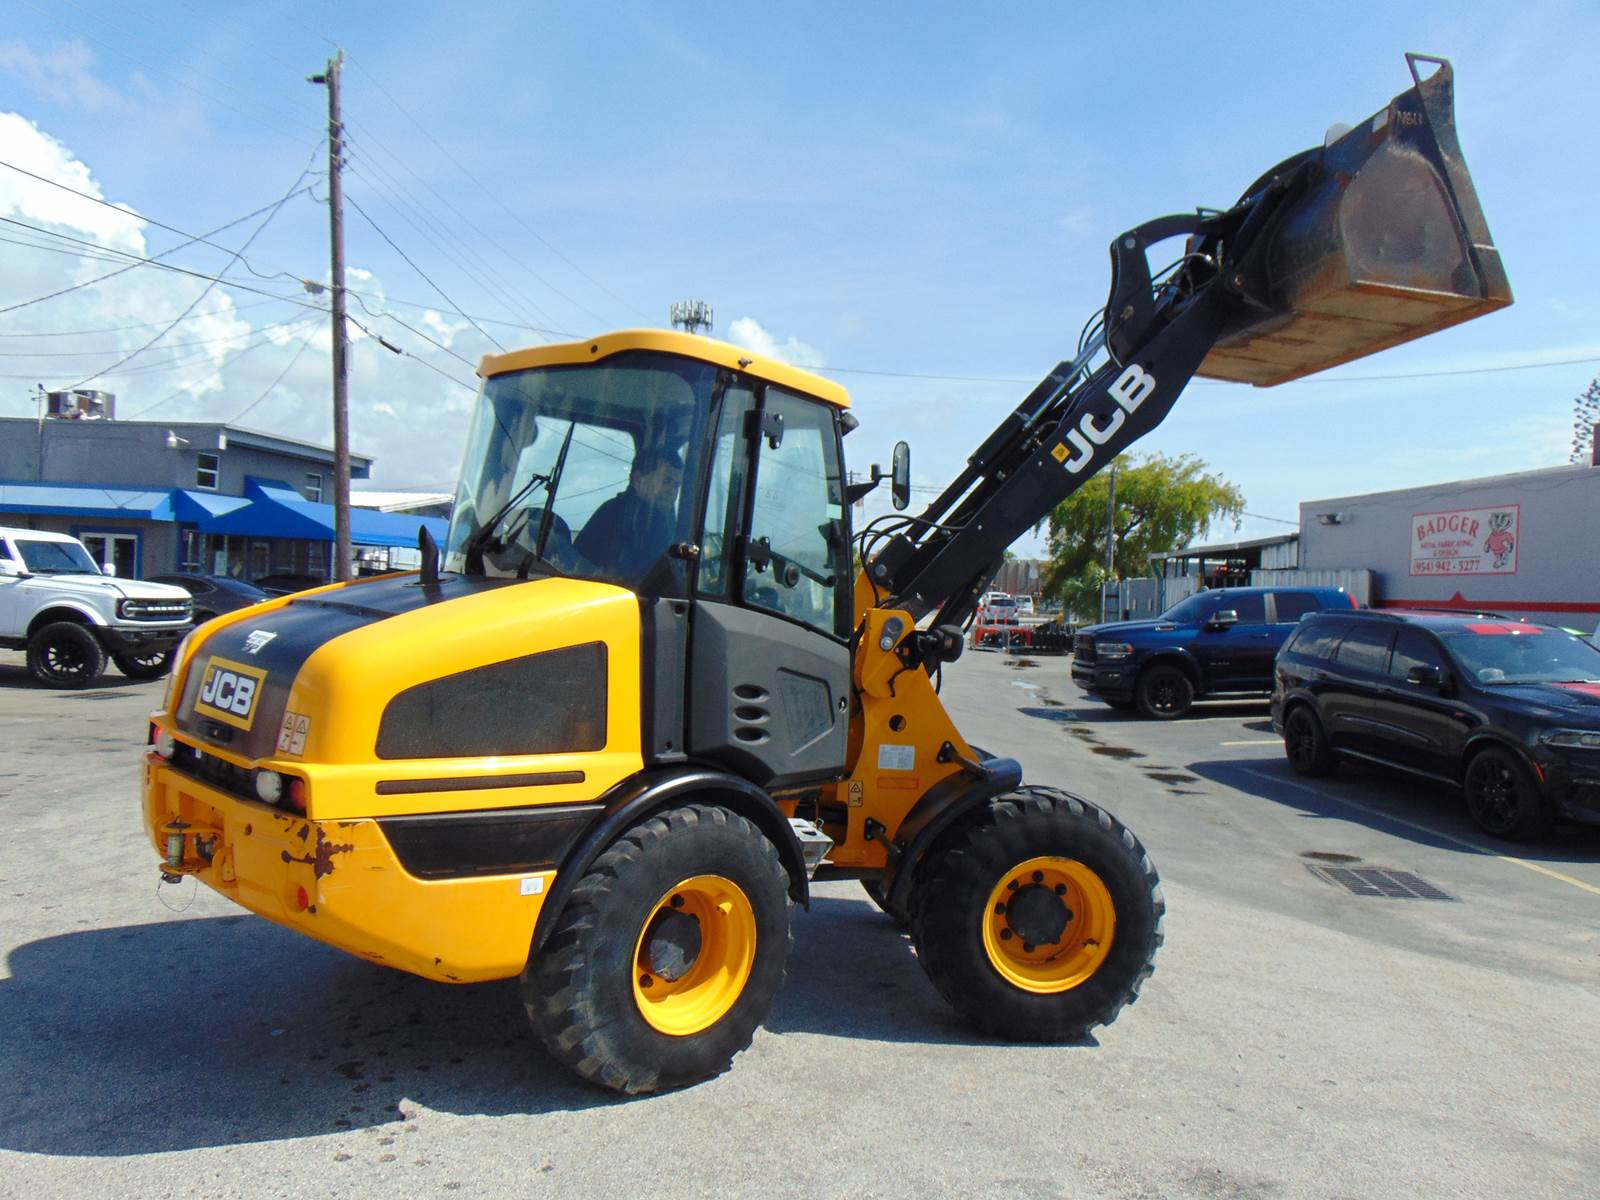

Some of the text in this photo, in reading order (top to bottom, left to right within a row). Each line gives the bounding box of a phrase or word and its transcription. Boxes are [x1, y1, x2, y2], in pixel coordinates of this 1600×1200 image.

[1064, 363, 1156, 474] JCB
[1417, 515, 1480, 541] BADGER
[1413, 561, 1434, 573] (954)
[1435, 560, 1451, 572] 942
[1458, 560, 1480, 571] 5277
[202, 670, 256, 715] JCB
